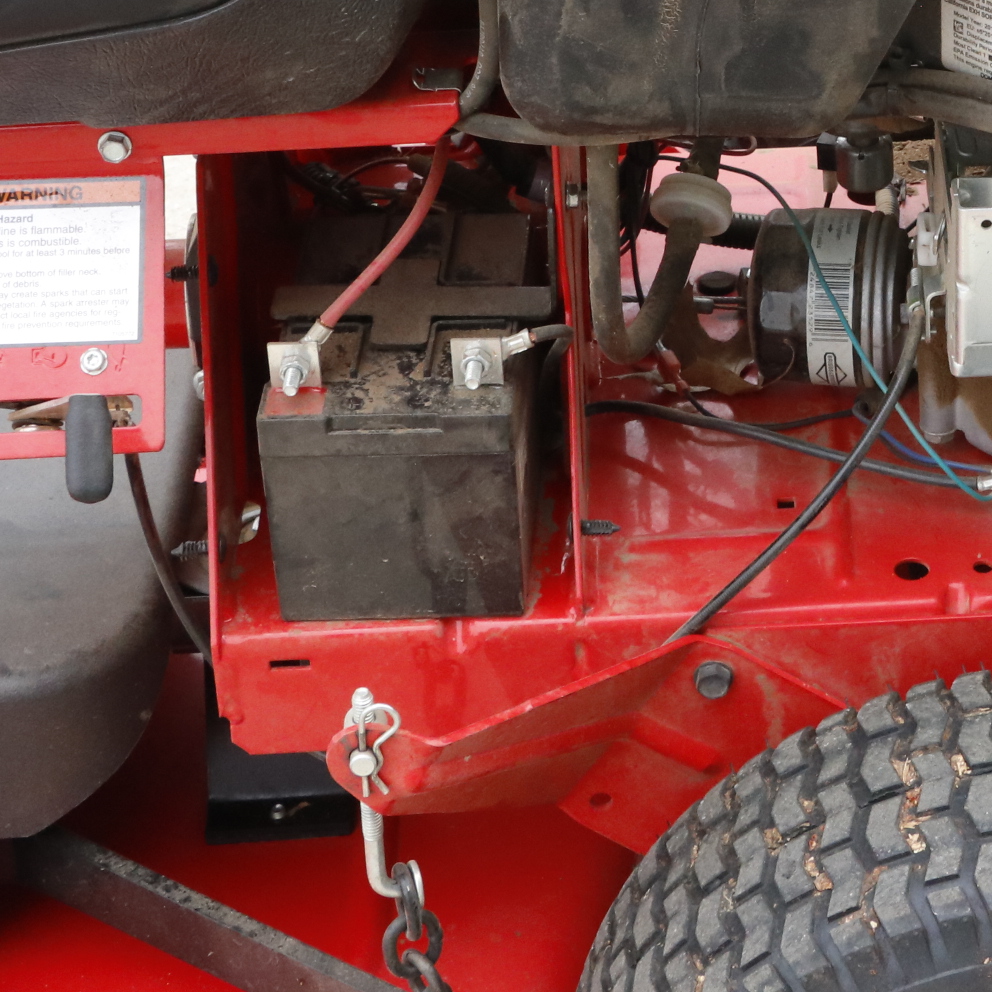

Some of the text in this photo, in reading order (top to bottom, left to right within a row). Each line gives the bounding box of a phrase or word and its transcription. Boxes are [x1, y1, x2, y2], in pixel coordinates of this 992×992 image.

[954, 10, 969, 21] Model
[969, 6, 980, 15] EXH
[954, 32, 978, 48] Durability
[954, 40, 966, 49] Most
[966, 46, 982, 56] Clean
[953, 47, 964, 56] EPA
[965, 52, 988, 66] Emission
[953, 54, 964, 64] This
[966, 60, 982, 72] engine
[20, 226, 28, 235] is
[31, 224, 86, 235] flammable.
[7, 239, 15, 248] is
[18, 237, 82, 248] combustible.
[12, 249, 23, 258] for
[26, 249, 34, 257] at
[36, 248, 57, 257] least
[60, 248, 64, 256] 3
[68, 247, 100, 256] minutes
[104, 246, 130, 255] before
[16, 269, 44, 278] bottom
[48, 268, 56, 277] of
[58, 268, 76, 276] filler
[78, 268, 101, 276] neck.
[11, 290, 38, 299] create
[40, 289, 69, 298] sparks
[72, 288, 88, 297] that
[90, 288, 106, 296] can
[109, 288, 128, 296] start
[40, 300, 46, 308] A
[50, 300, 73, 308] spark
[76, 299, 108, 307] arrester
[112, 298, 130, 307] may
[10, 311, 30, 319] local
[33, 310, 46, 318] fire
[50, 309, 88, 319] agencies
[90, 308, 101, 317] for
[2, 322, 15, 330] fire
[18, 320, 62, 330] prevention
